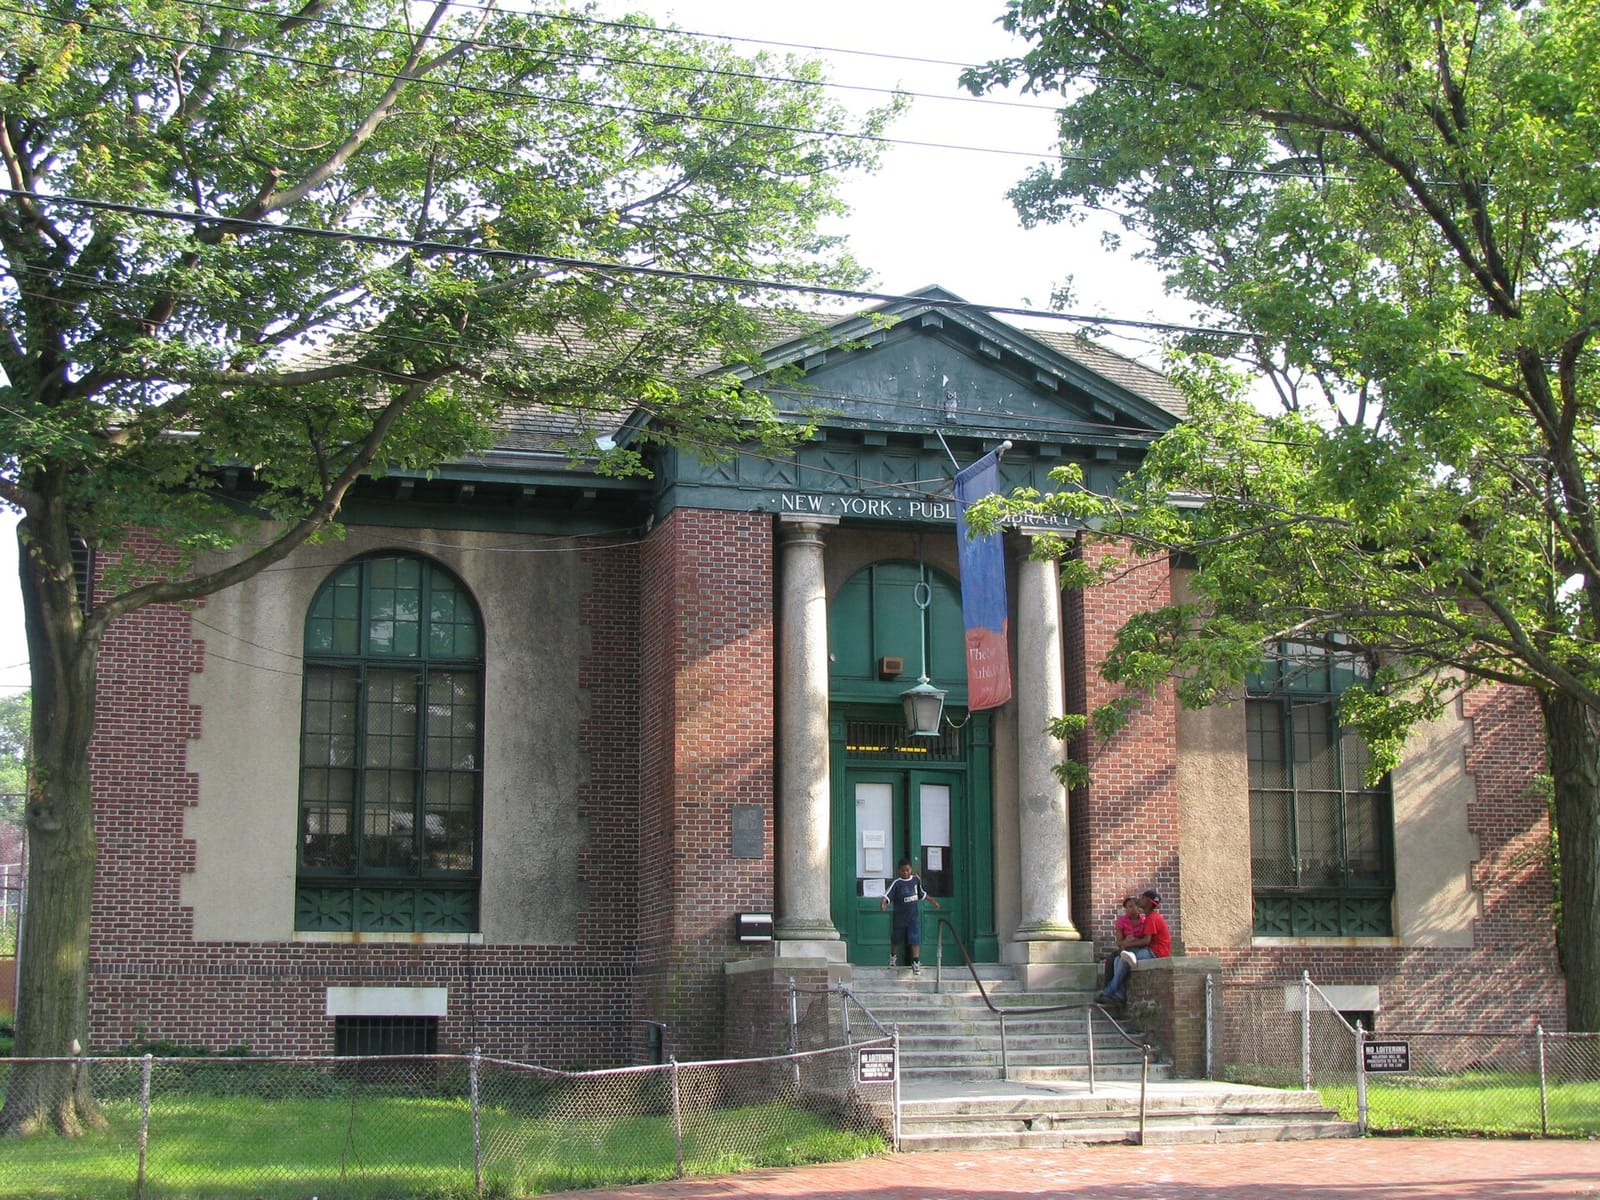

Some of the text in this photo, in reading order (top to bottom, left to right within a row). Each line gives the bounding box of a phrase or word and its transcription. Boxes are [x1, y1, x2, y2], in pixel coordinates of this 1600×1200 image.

[781, 493, 823, 512] NEW
[840, 497, 893, 517] YORK
[909, 501, 957, 520] PUBL
[1366, 1046, 1406, 1054] NO LOITERING
[869, 1054, 893, 1063] LOITERING
